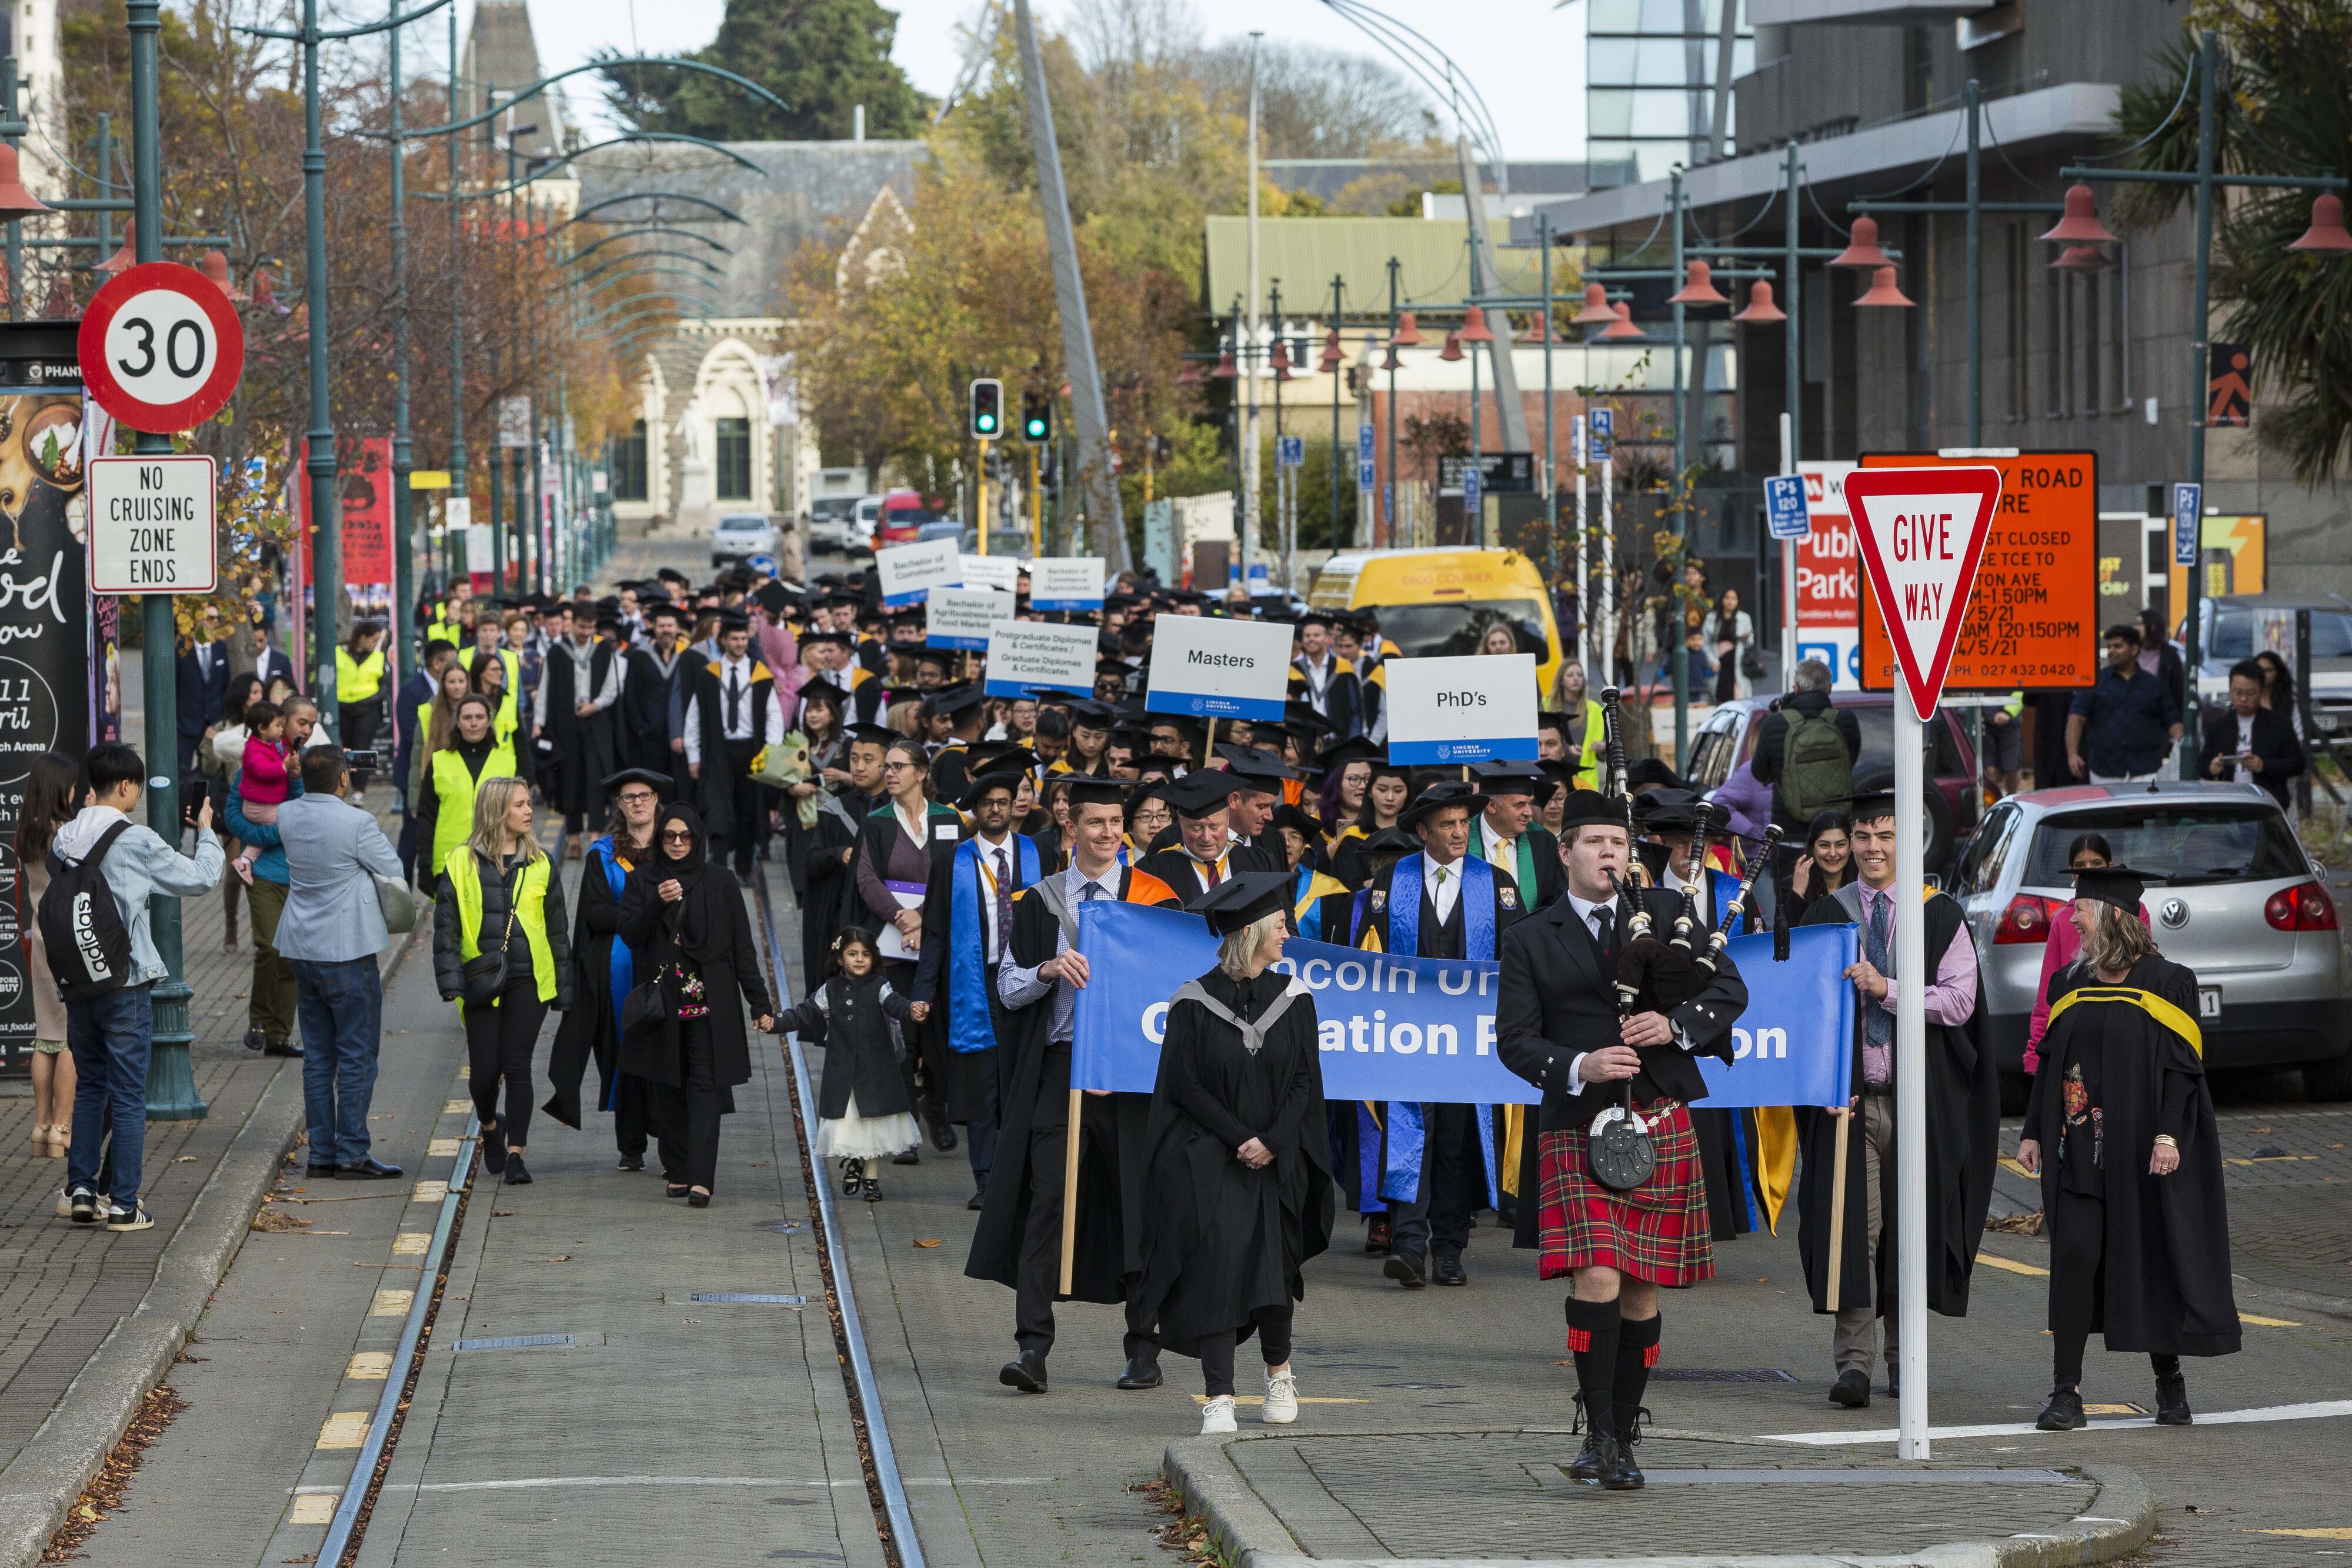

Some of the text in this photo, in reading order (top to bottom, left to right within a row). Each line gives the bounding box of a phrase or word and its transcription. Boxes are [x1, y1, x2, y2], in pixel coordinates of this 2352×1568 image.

[118, 317, 205, 378] 30
[139, 466, 163, 490] NO
[2021, 468, 2083, 488] ROAD
[110, 497, 194, 522] CRUISING
[129, 528, 176, 552] ZONE
[1893, 513, 1954, 562] GIVE
[2008, 531, 2071, 546] CLOSED
[893, 553, 944, 571] Bachelor of
[2001, 552, 2031, 566] TCE
[2035, 552, 2055, 566] TO
[130, 559, 176, 583] ENDS
[895, 565, 946, 581] Commerce
[1977, 573, 2041, 586] TON AVE
[946, 598, 996, 609] Bachelor of
[1904, 582, 1943, 621] WAY
[933, 608, 989, 619] Agribusiness
[936, 618, 959, 627] Food
[995, 630, 1092, 645] Postgraduate Diplomas
[1019, 641, 1069, 653] Certificates
[1001, 653, 1083, 668] Graduate Diplomas
[1188, 649, 1255, 668] Masters
[1012, 663, 1070, 676] & Certificates
[1981, 665, 2006, 676] 027
[2010, 665, 2036, 676] 432
[2040, 664, 2076, 676] 0420
[1437, 691, 1487, 707] PhD's
[13, 741, 46, 752] Arena
[76, 899, 108, 973] adidas
